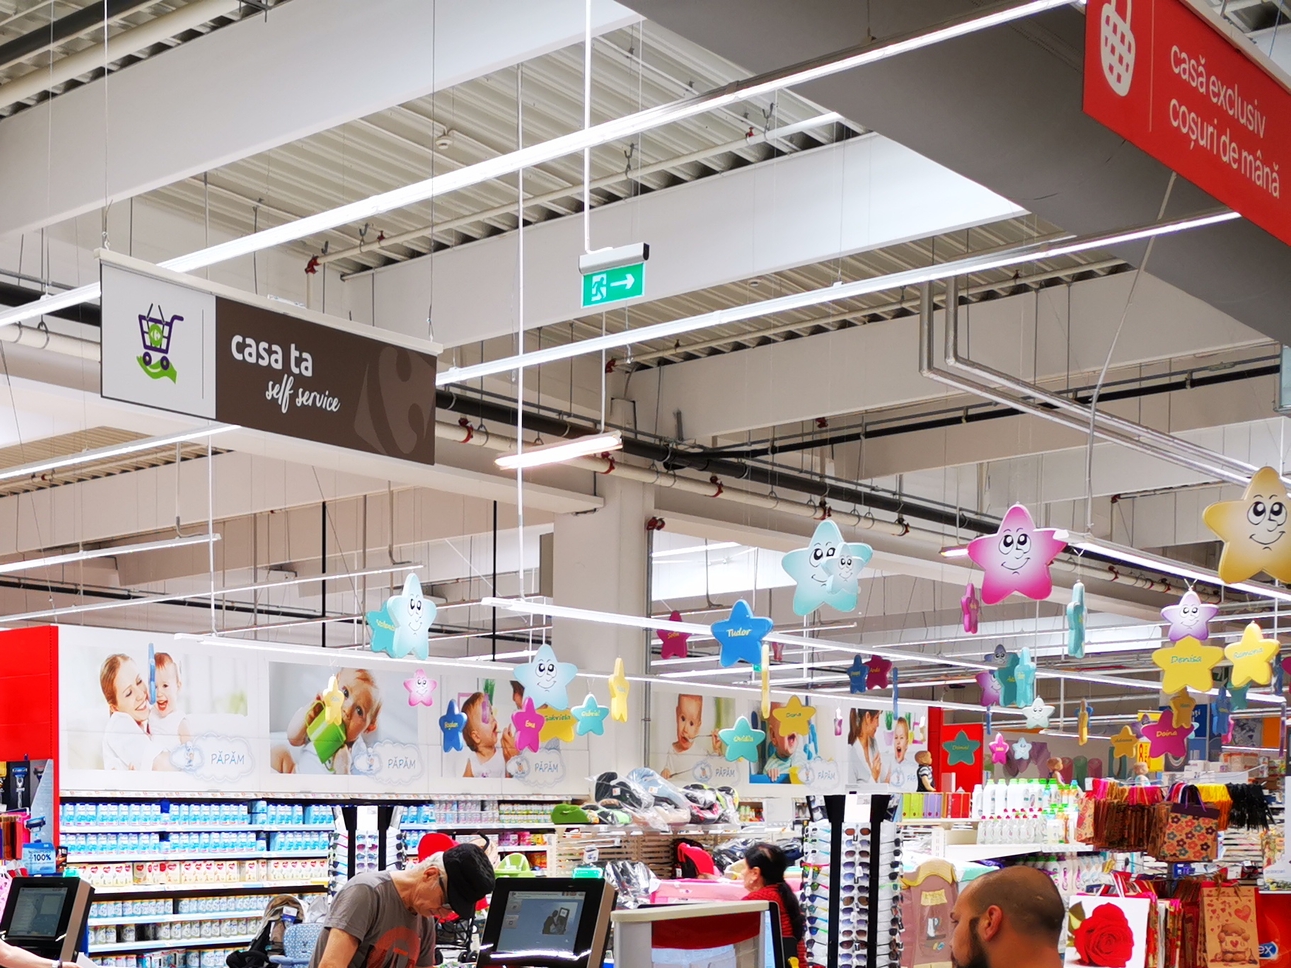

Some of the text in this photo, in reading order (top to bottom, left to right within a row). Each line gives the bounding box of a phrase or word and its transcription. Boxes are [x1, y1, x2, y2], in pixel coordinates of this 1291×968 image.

[1171, 45, 1266, 138] casă exclusiv
[1169, 98, 1279, 199] coșuri de mână
[231, 331, 314, 378] casa ta
[265, 373, 341, 413] self service
[726, 627, 752, 637] Tudor
[1171, 654, 1201, 664] Denisa
[1156, 729, 1177, 738] Doina
[211, 750, 245, 767] PĂPĂM
[387, 754, 416, 770] PĂPĂM
[534, 759, 559, 774] PĂPĂM
[715, 767, 735, 777] PĂPĂM
[816, 770, 836, 780] PĂPĂM
[33, 853, 52, 861] 100%
